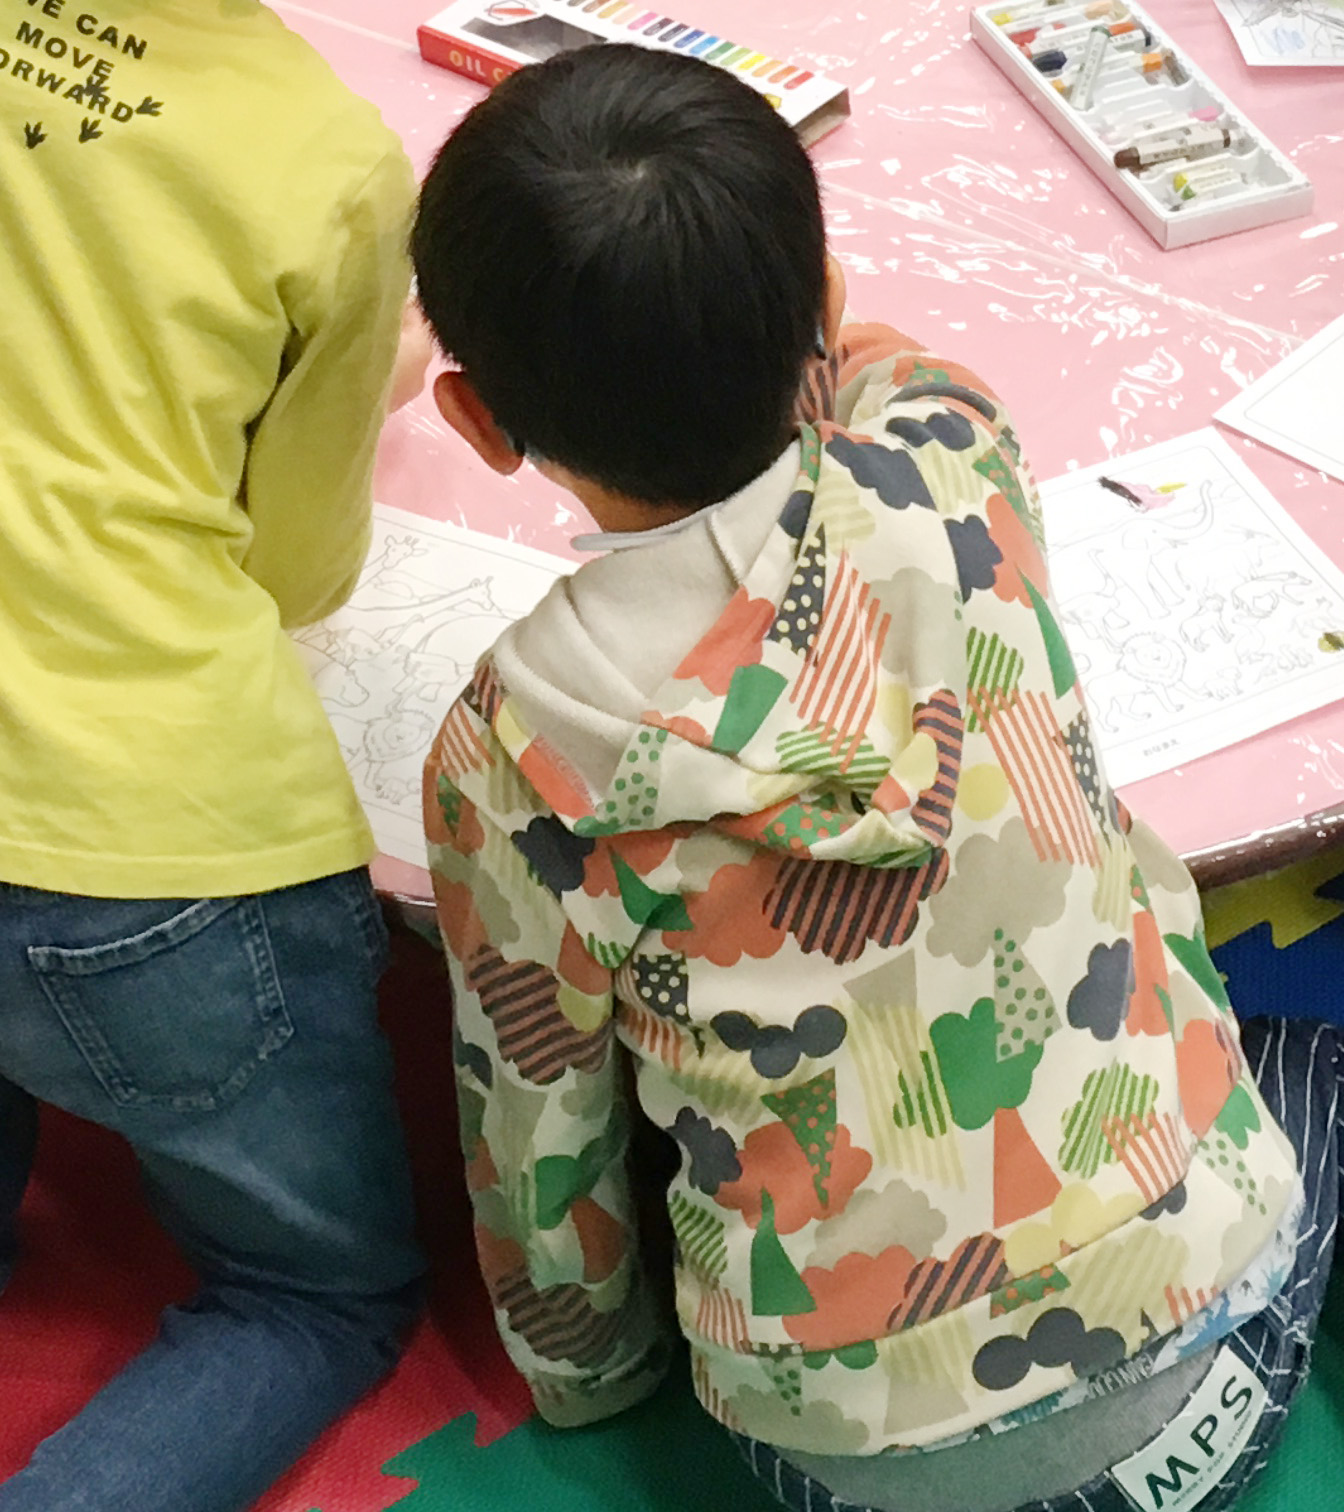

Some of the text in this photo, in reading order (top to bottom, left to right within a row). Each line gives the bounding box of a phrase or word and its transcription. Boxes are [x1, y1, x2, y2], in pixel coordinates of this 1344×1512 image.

[15, 20, 116, 82] MOVE
[75, 13, 148, 60] CAN
[448, 50, 487, 76] OIL
[1144, 1375, 1255, 1511] MPS
